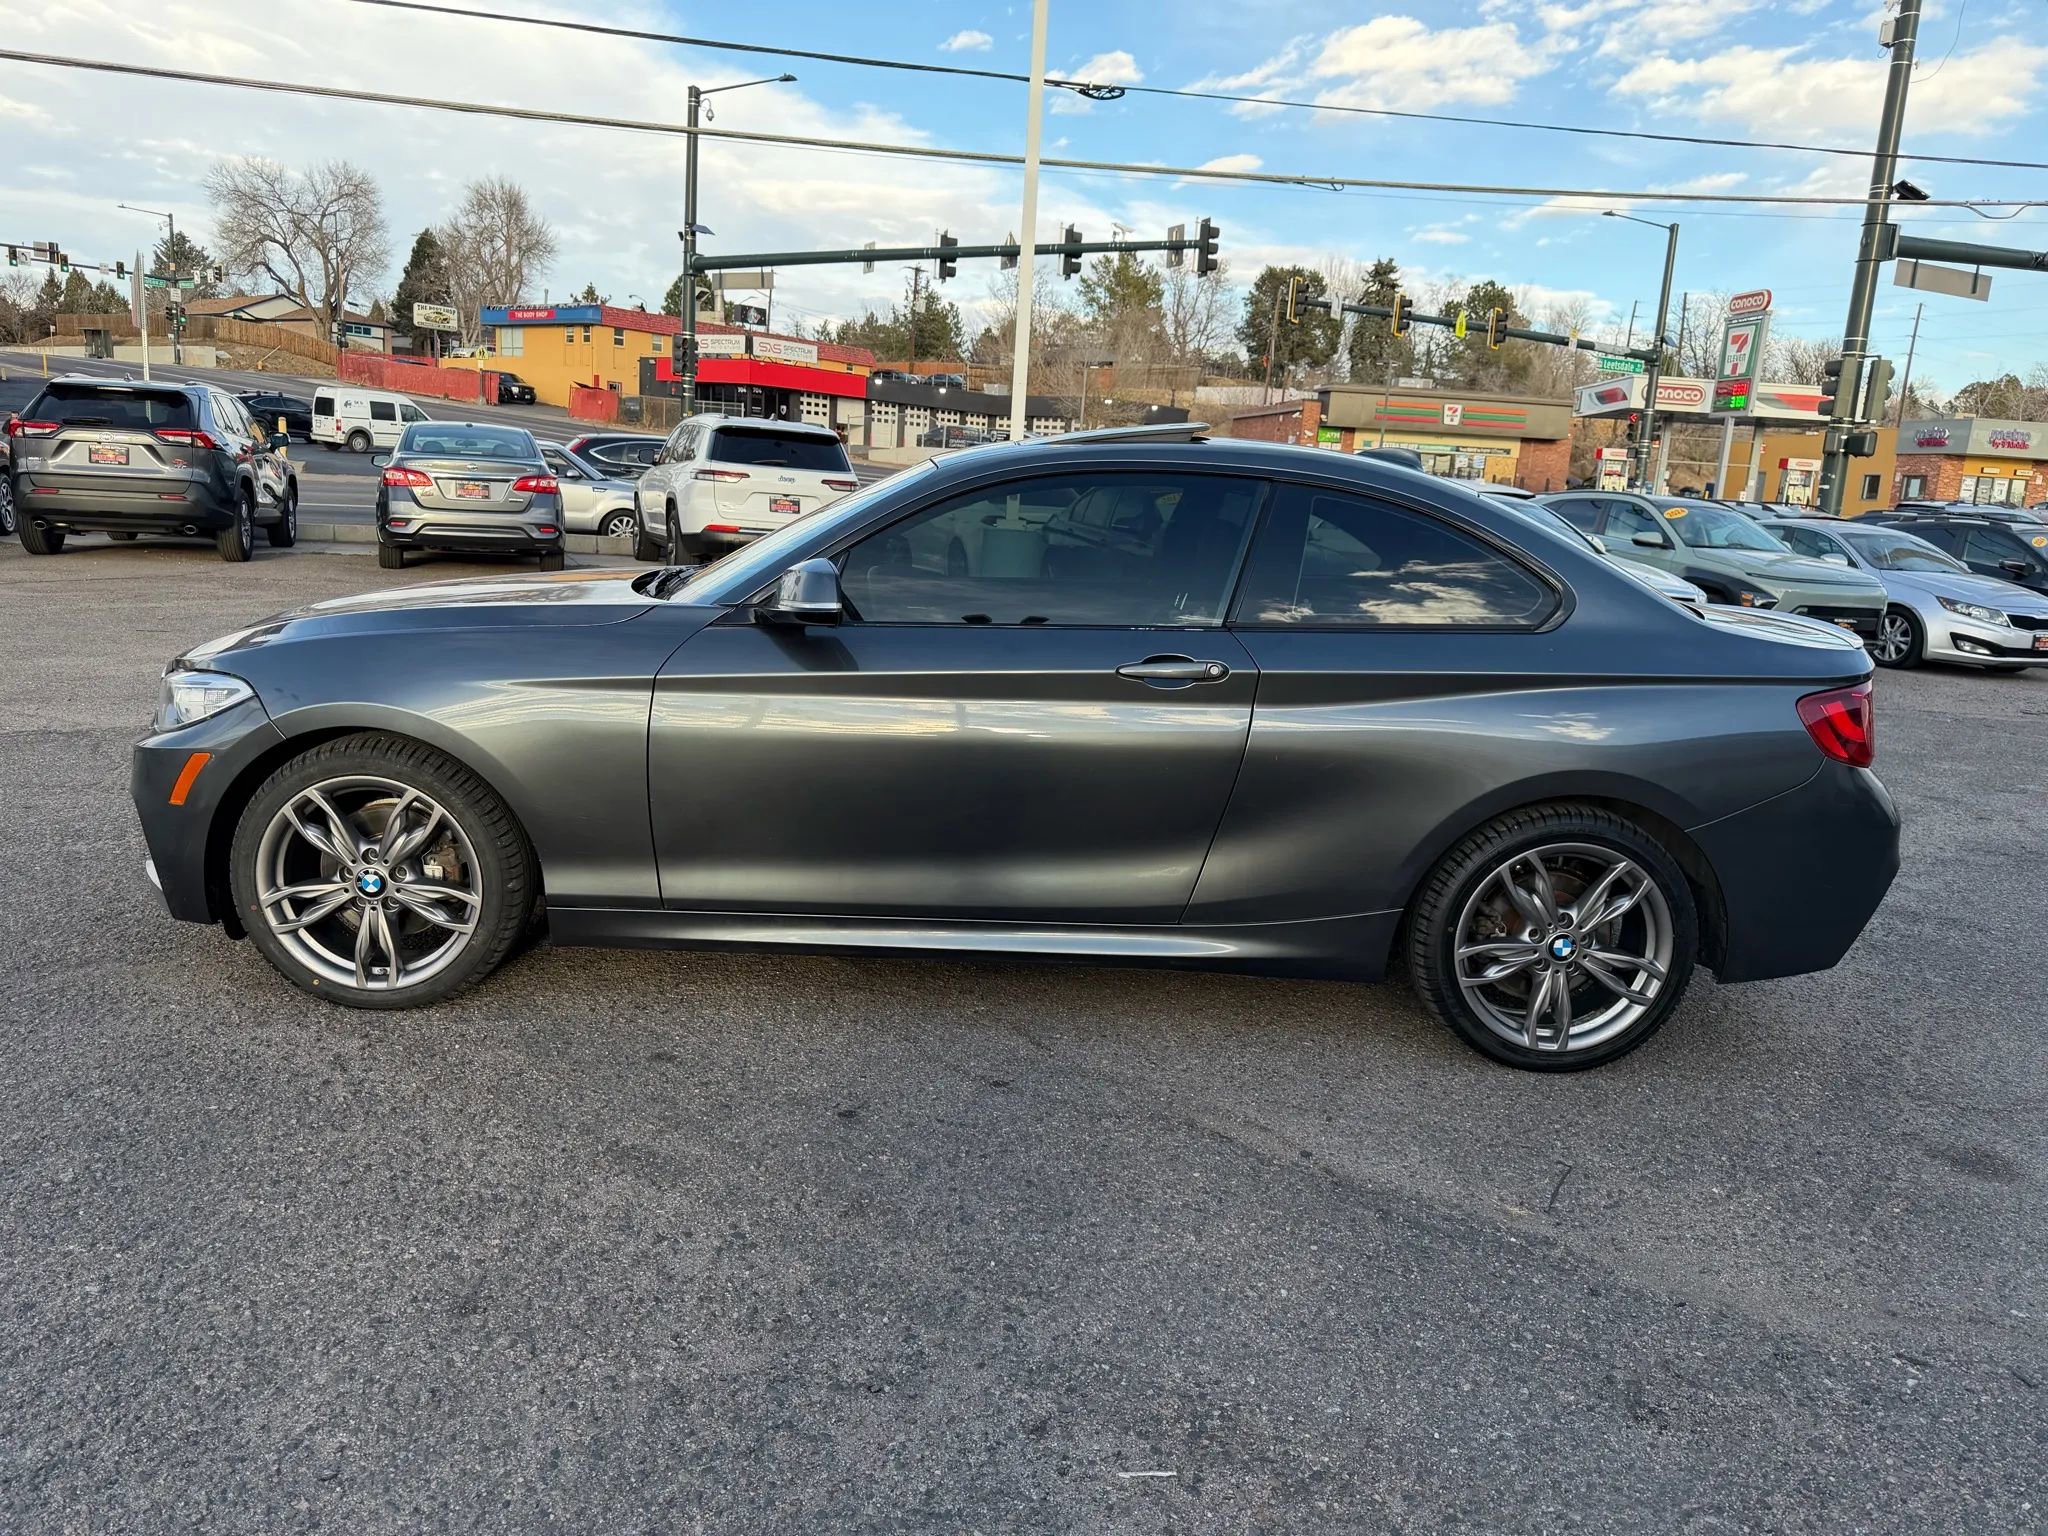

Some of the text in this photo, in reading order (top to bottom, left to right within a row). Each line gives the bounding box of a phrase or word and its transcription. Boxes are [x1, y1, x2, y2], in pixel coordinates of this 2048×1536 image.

[443, 307, 456, 315] SHOP
[783, 345, 813, 353] SPECTRUM
[1603, 359, 1634, 372] Leetsdale
